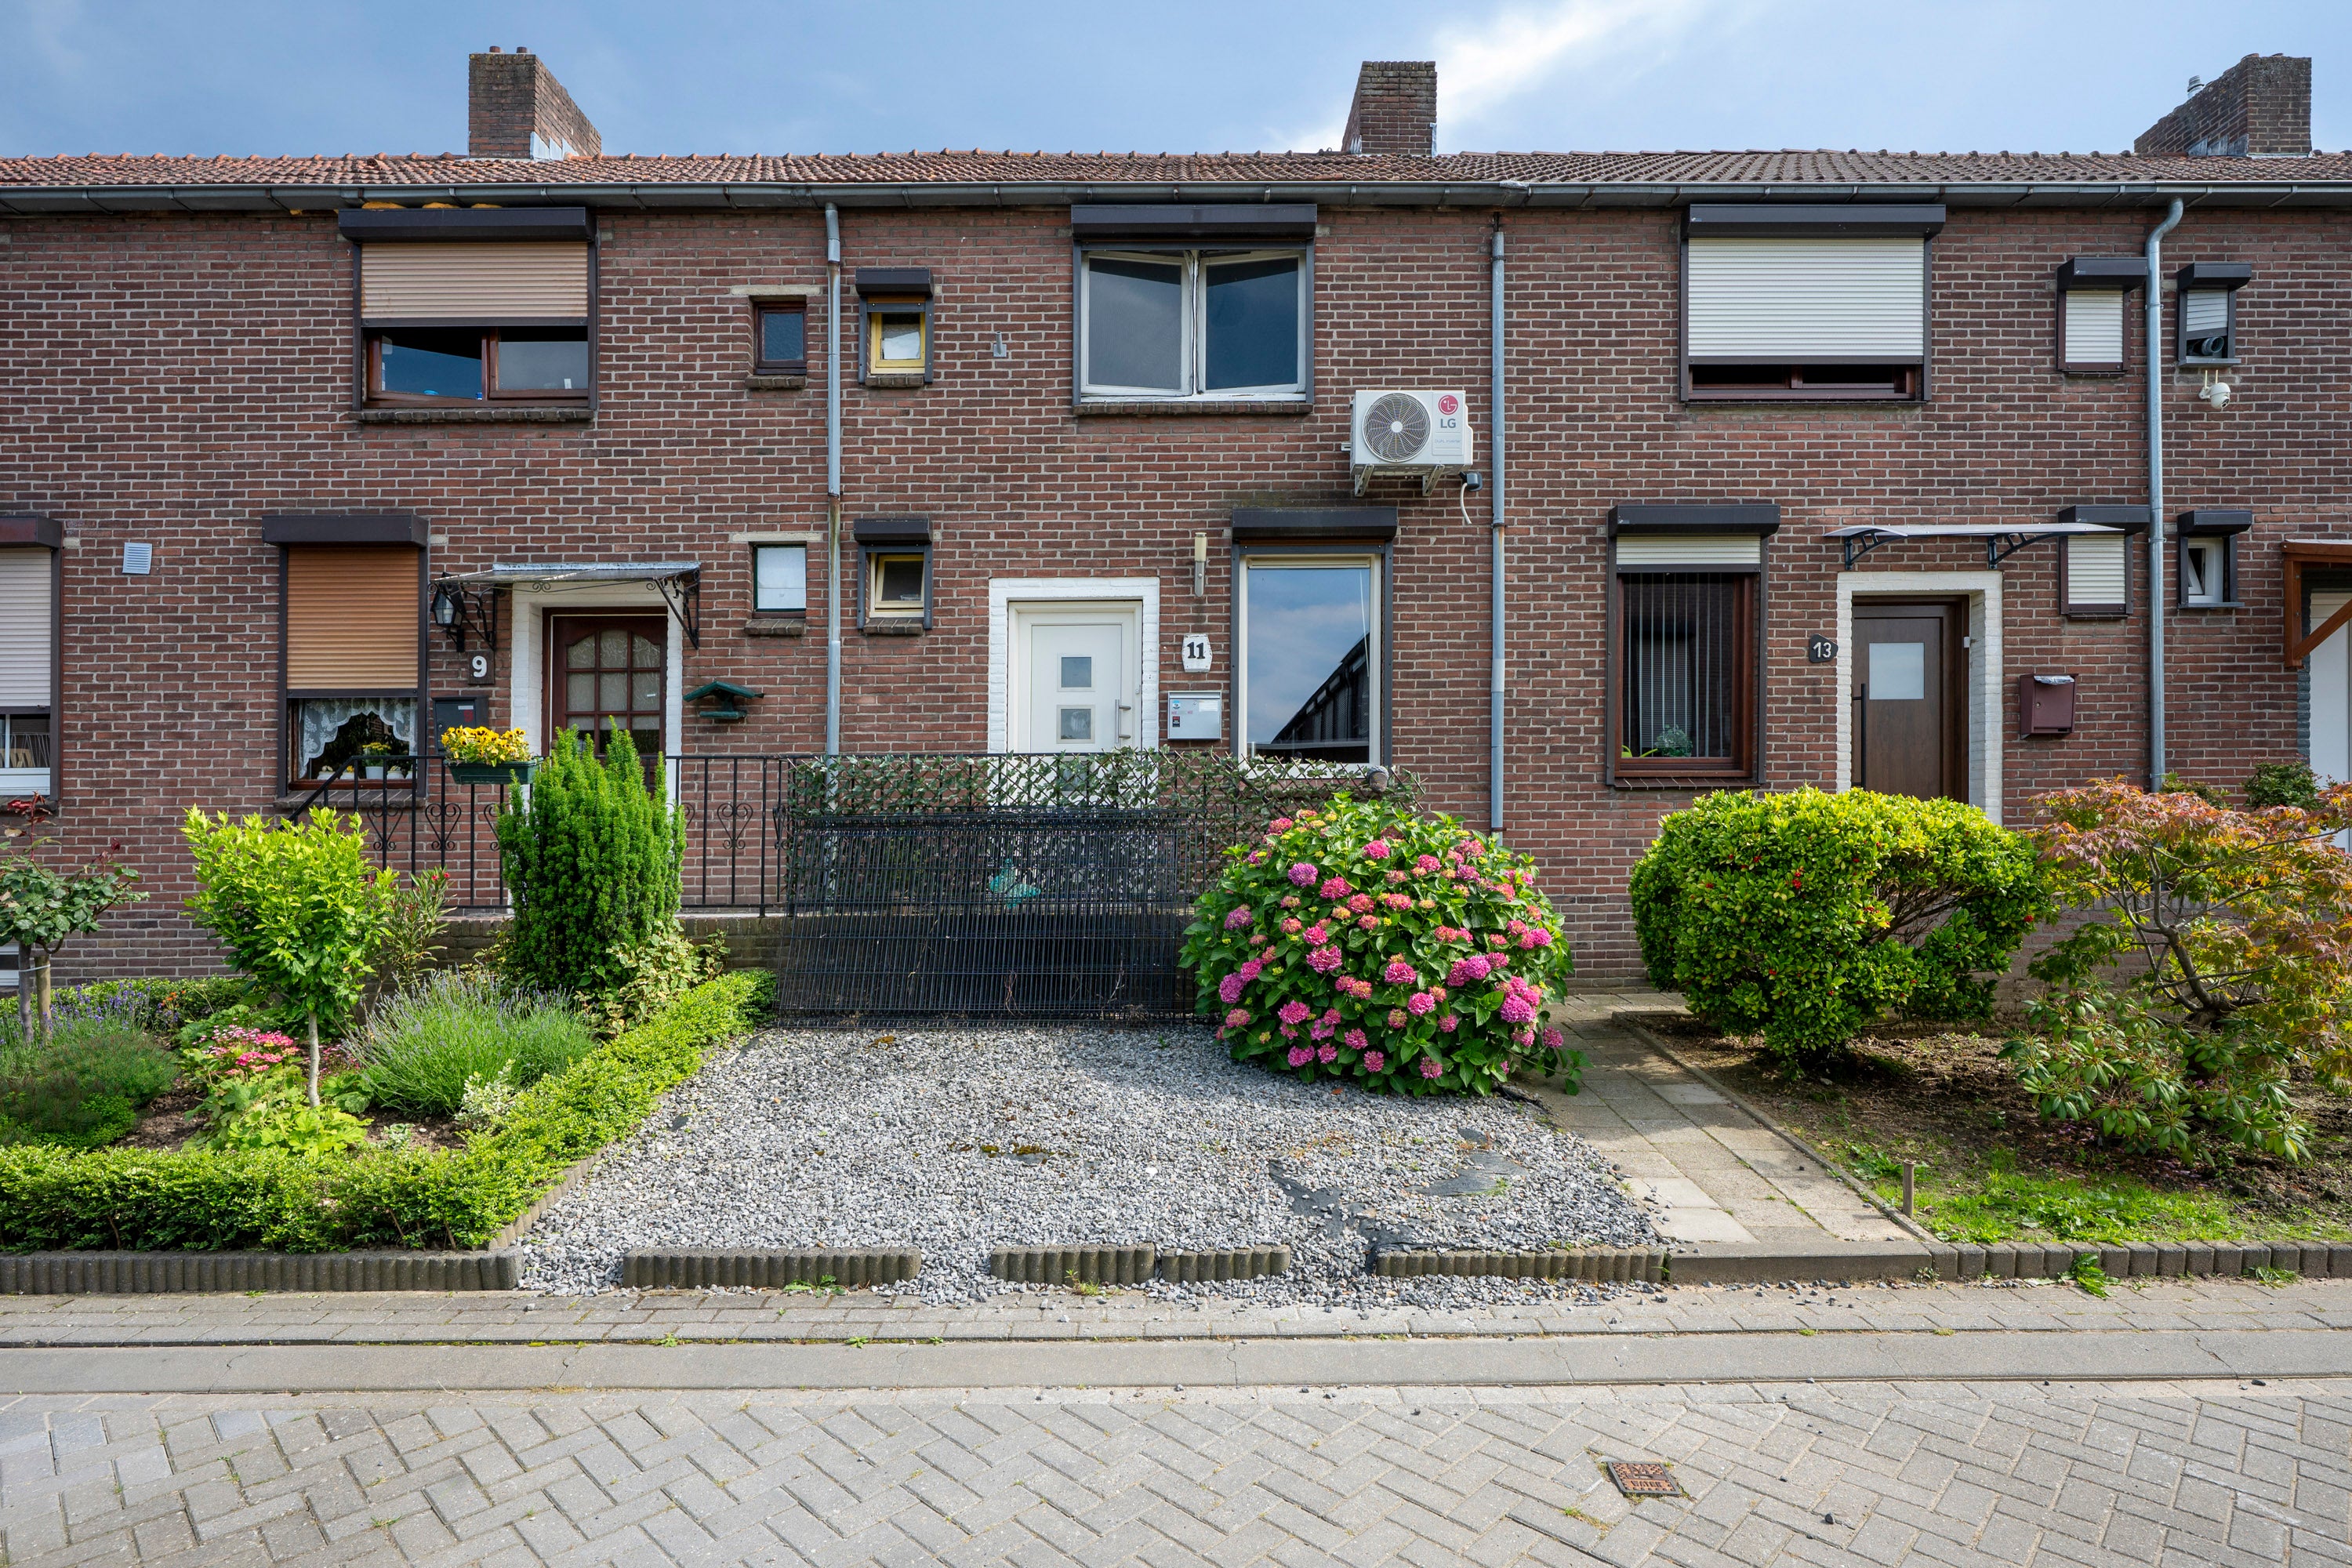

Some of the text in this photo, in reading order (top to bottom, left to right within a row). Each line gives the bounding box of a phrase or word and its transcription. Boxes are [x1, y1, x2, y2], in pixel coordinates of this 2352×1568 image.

[1440, 418, 1456, 428] LG
[1186, 641, 1206, 659] 11
[1813, 641, 1831, 659] 13
[472, 655, 488, 677] 9
[463, 710, 474, 723] 9
